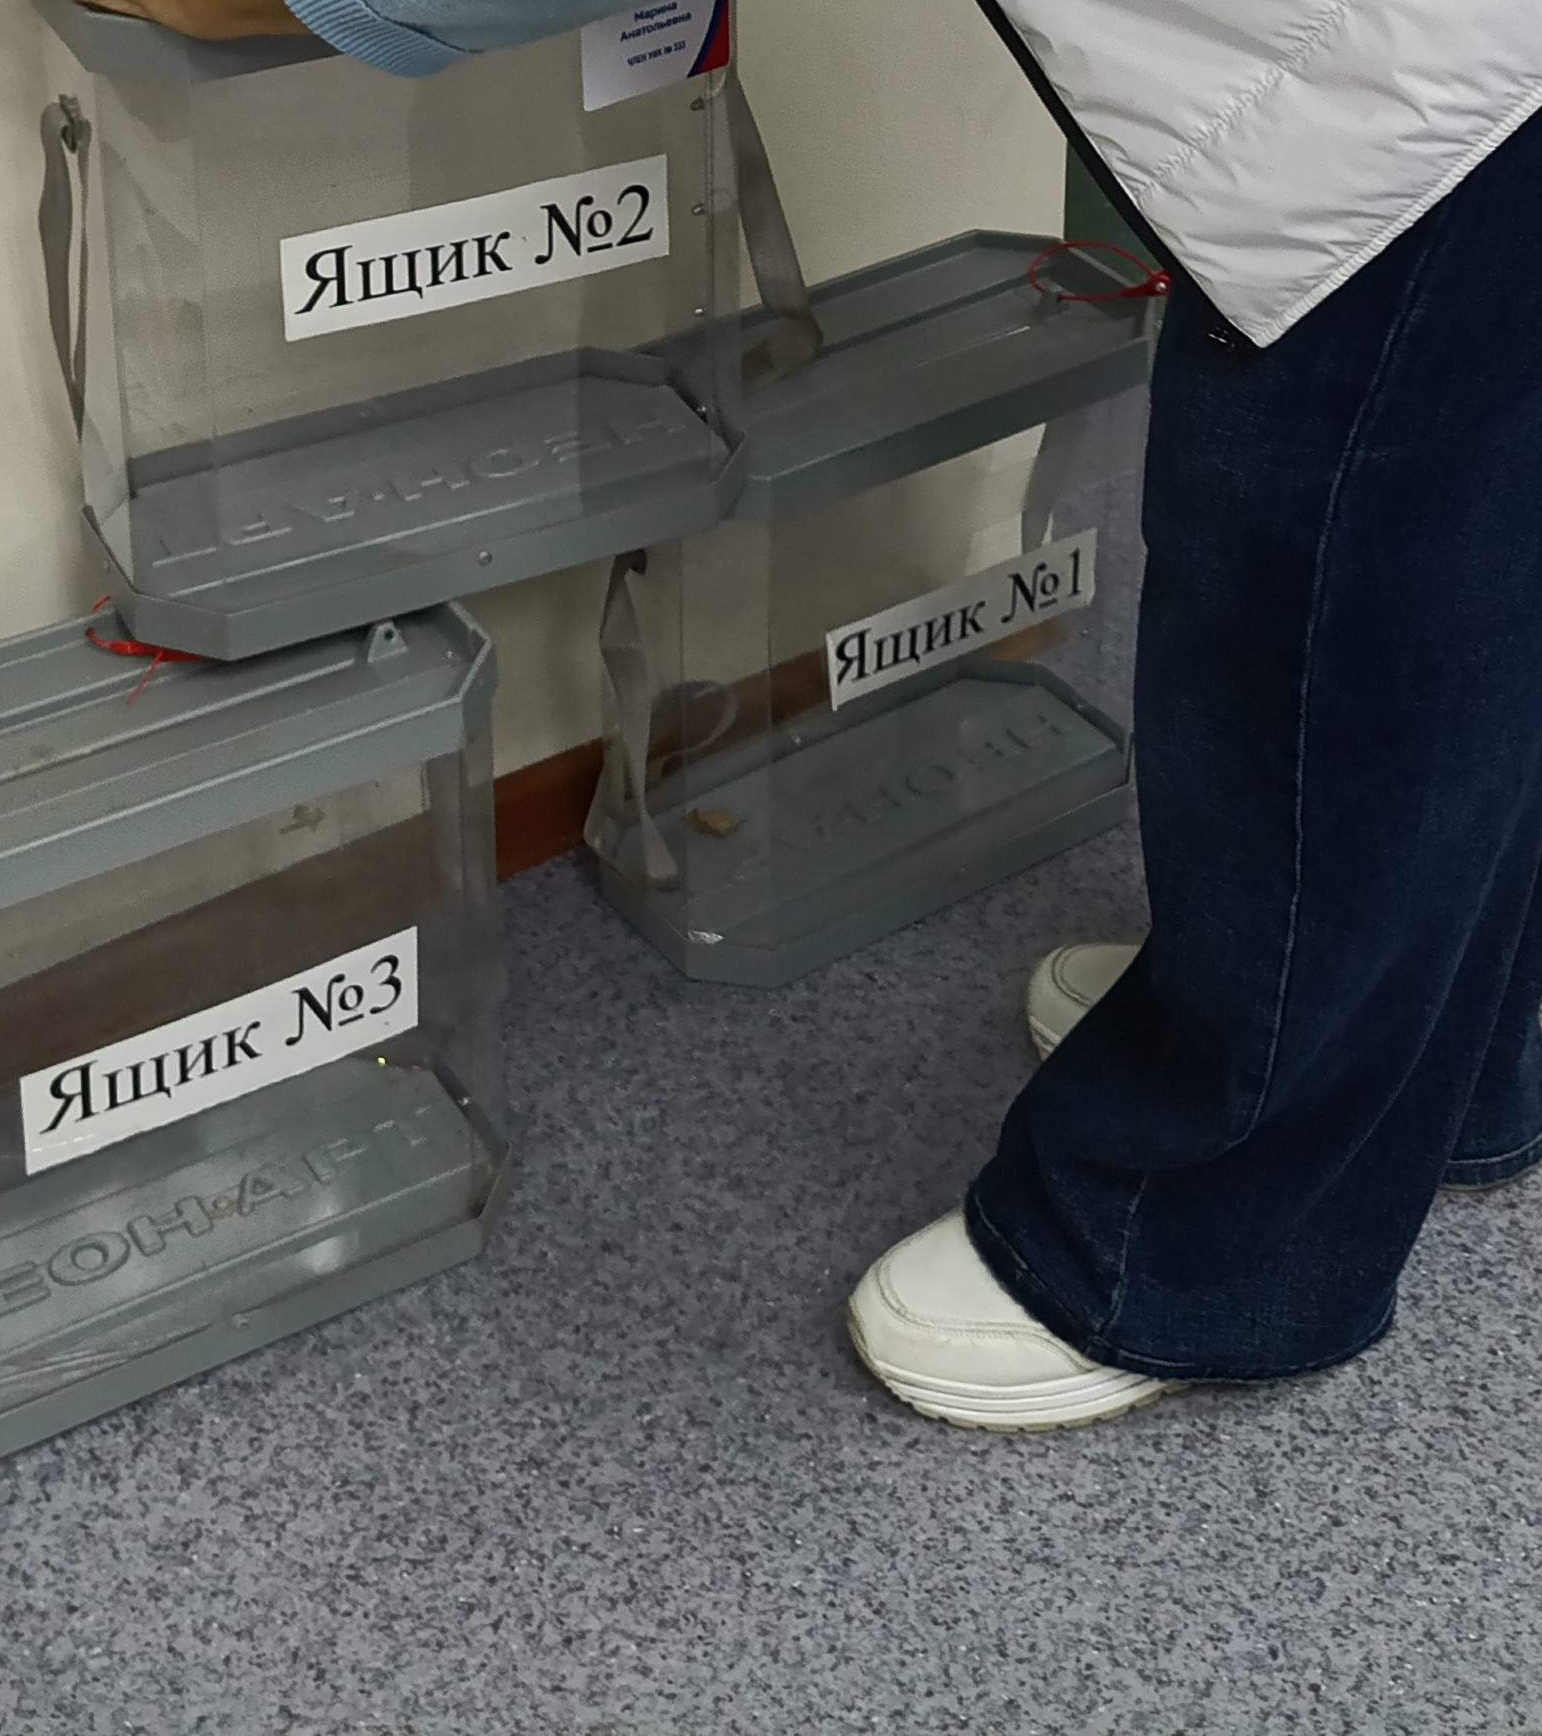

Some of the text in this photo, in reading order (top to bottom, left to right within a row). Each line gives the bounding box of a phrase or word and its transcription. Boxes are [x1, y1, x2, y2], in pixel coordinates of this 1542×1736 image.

[619, 12, 693, 43] Анатольевна
[633, 1, 678, 22] Марина
[294, 183, 655, 317] Ящик №2
[834, 547, 1087, 685] Ящик №1
[39, 953, 404, 1135] Ящик №3
